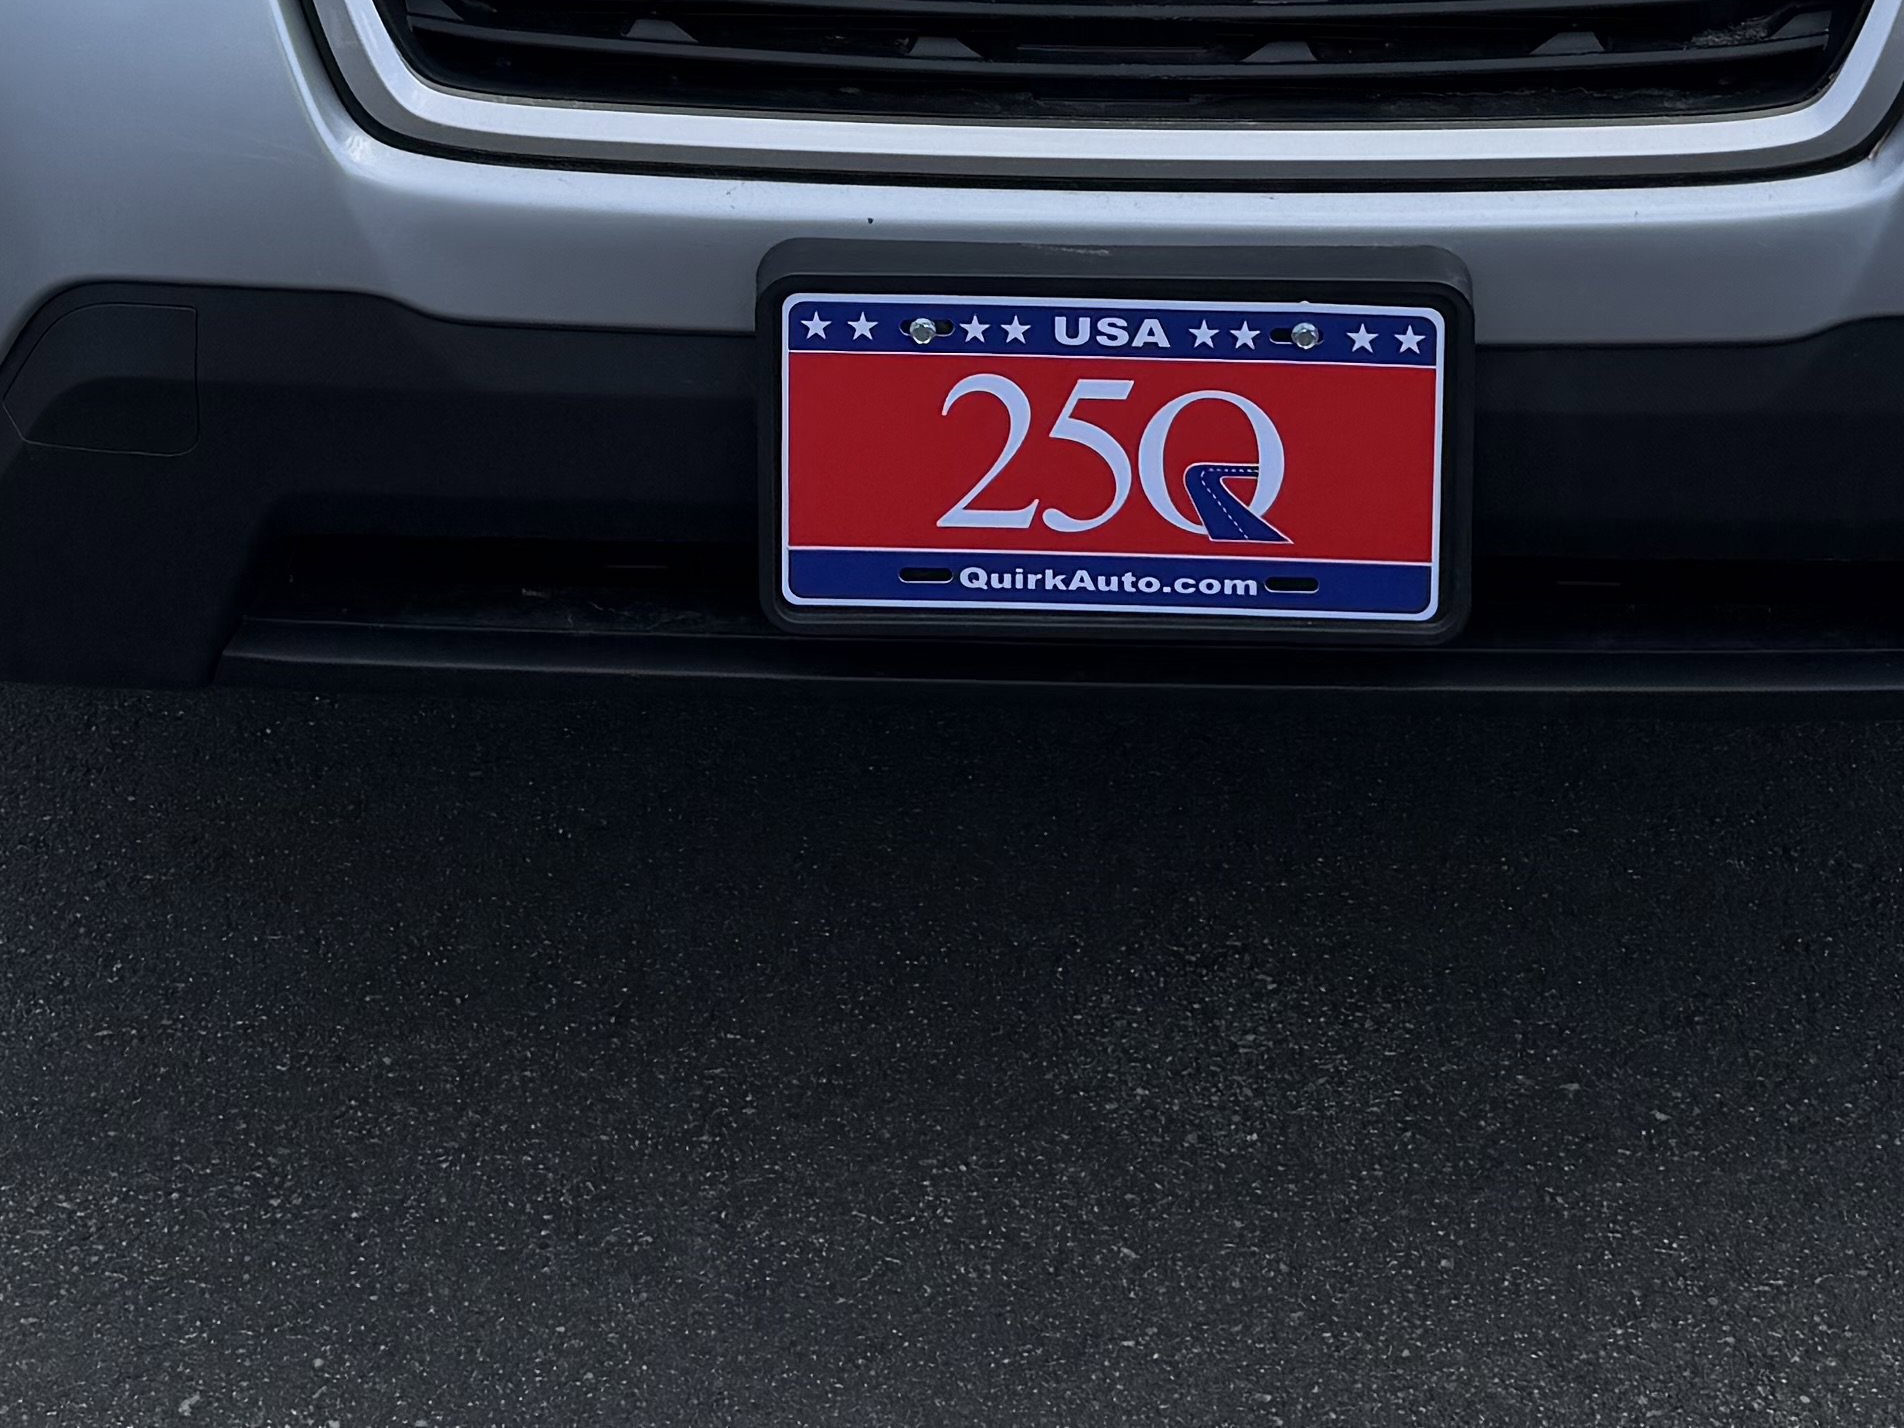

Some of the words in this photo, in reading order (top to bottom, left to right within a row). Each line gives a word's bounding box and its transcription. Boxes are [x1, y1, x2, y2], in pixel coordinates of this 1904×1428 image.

[1053, 315, 1171, 349] USA
[936, 372, 1294, 545] 25Q
[959, 565, 1259, 597] QuirkAuto.com
